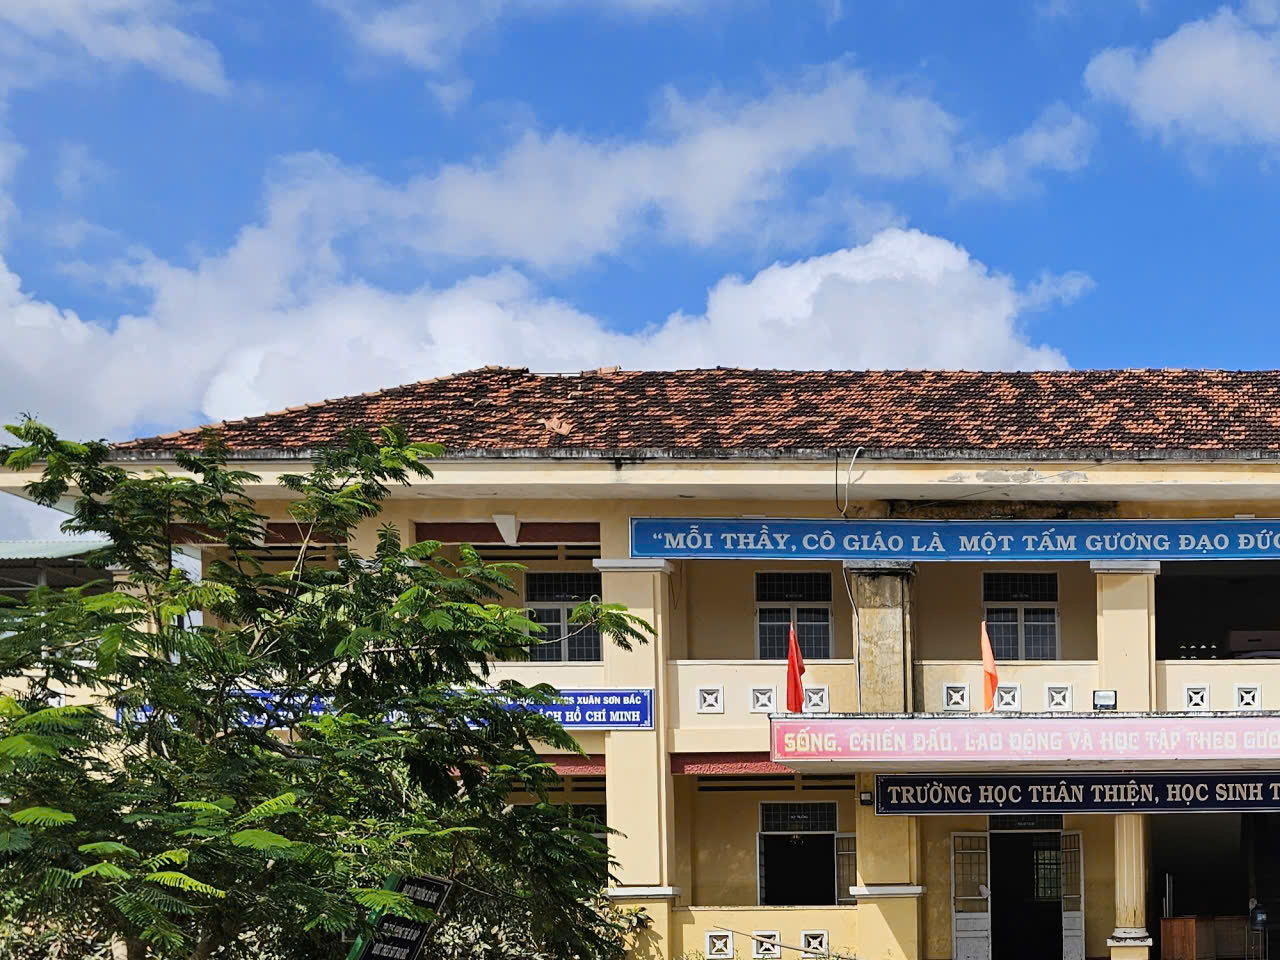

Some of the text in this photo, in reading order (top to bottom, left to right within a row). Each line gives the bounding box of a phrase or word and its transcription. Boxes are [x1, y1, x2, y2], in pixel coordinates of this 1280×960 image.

[653, 526, 712, 549] “MỖI
[721, 525, 797, 551] THẦY,
[802, 530, 835, 550] CÔ
[843, 529, 903, 551] GIÁO
[912, 530, 945, 552] LÀ
[959, 532, 1014, 554] MỘT
[1022, 528, 1075, 551] TẤM
[1086, 533, 1170, 551] GƯƠNG
[1179, 533, 1230, 554] ĐẠO
[577, 695, 600, 704] XUÂN
[603, 696, 621, 704] SƠN
[566, 706, 581, 722] HỒ
[586, 708, 606, 721] CHÍ
[610, 711, 640, 721] MINH
[965, 731, 1002, 751] LAO
[1068, 728, 1093, 750] VÀ
[1100, 732, 1139, 753] HỌC
[1187, 731, 1236, 750] THEO
[888, 782, 971, 804] TRƯỜNG
[978, 785, 1022, 807] HỌC
[1028, 780, 1083, 802] THÂN
[1091, 780, 1159, 806] THIỆN,
[1166, 783, 1209, 806] HỌC
[1216, 783, 1263, 801] SINH
